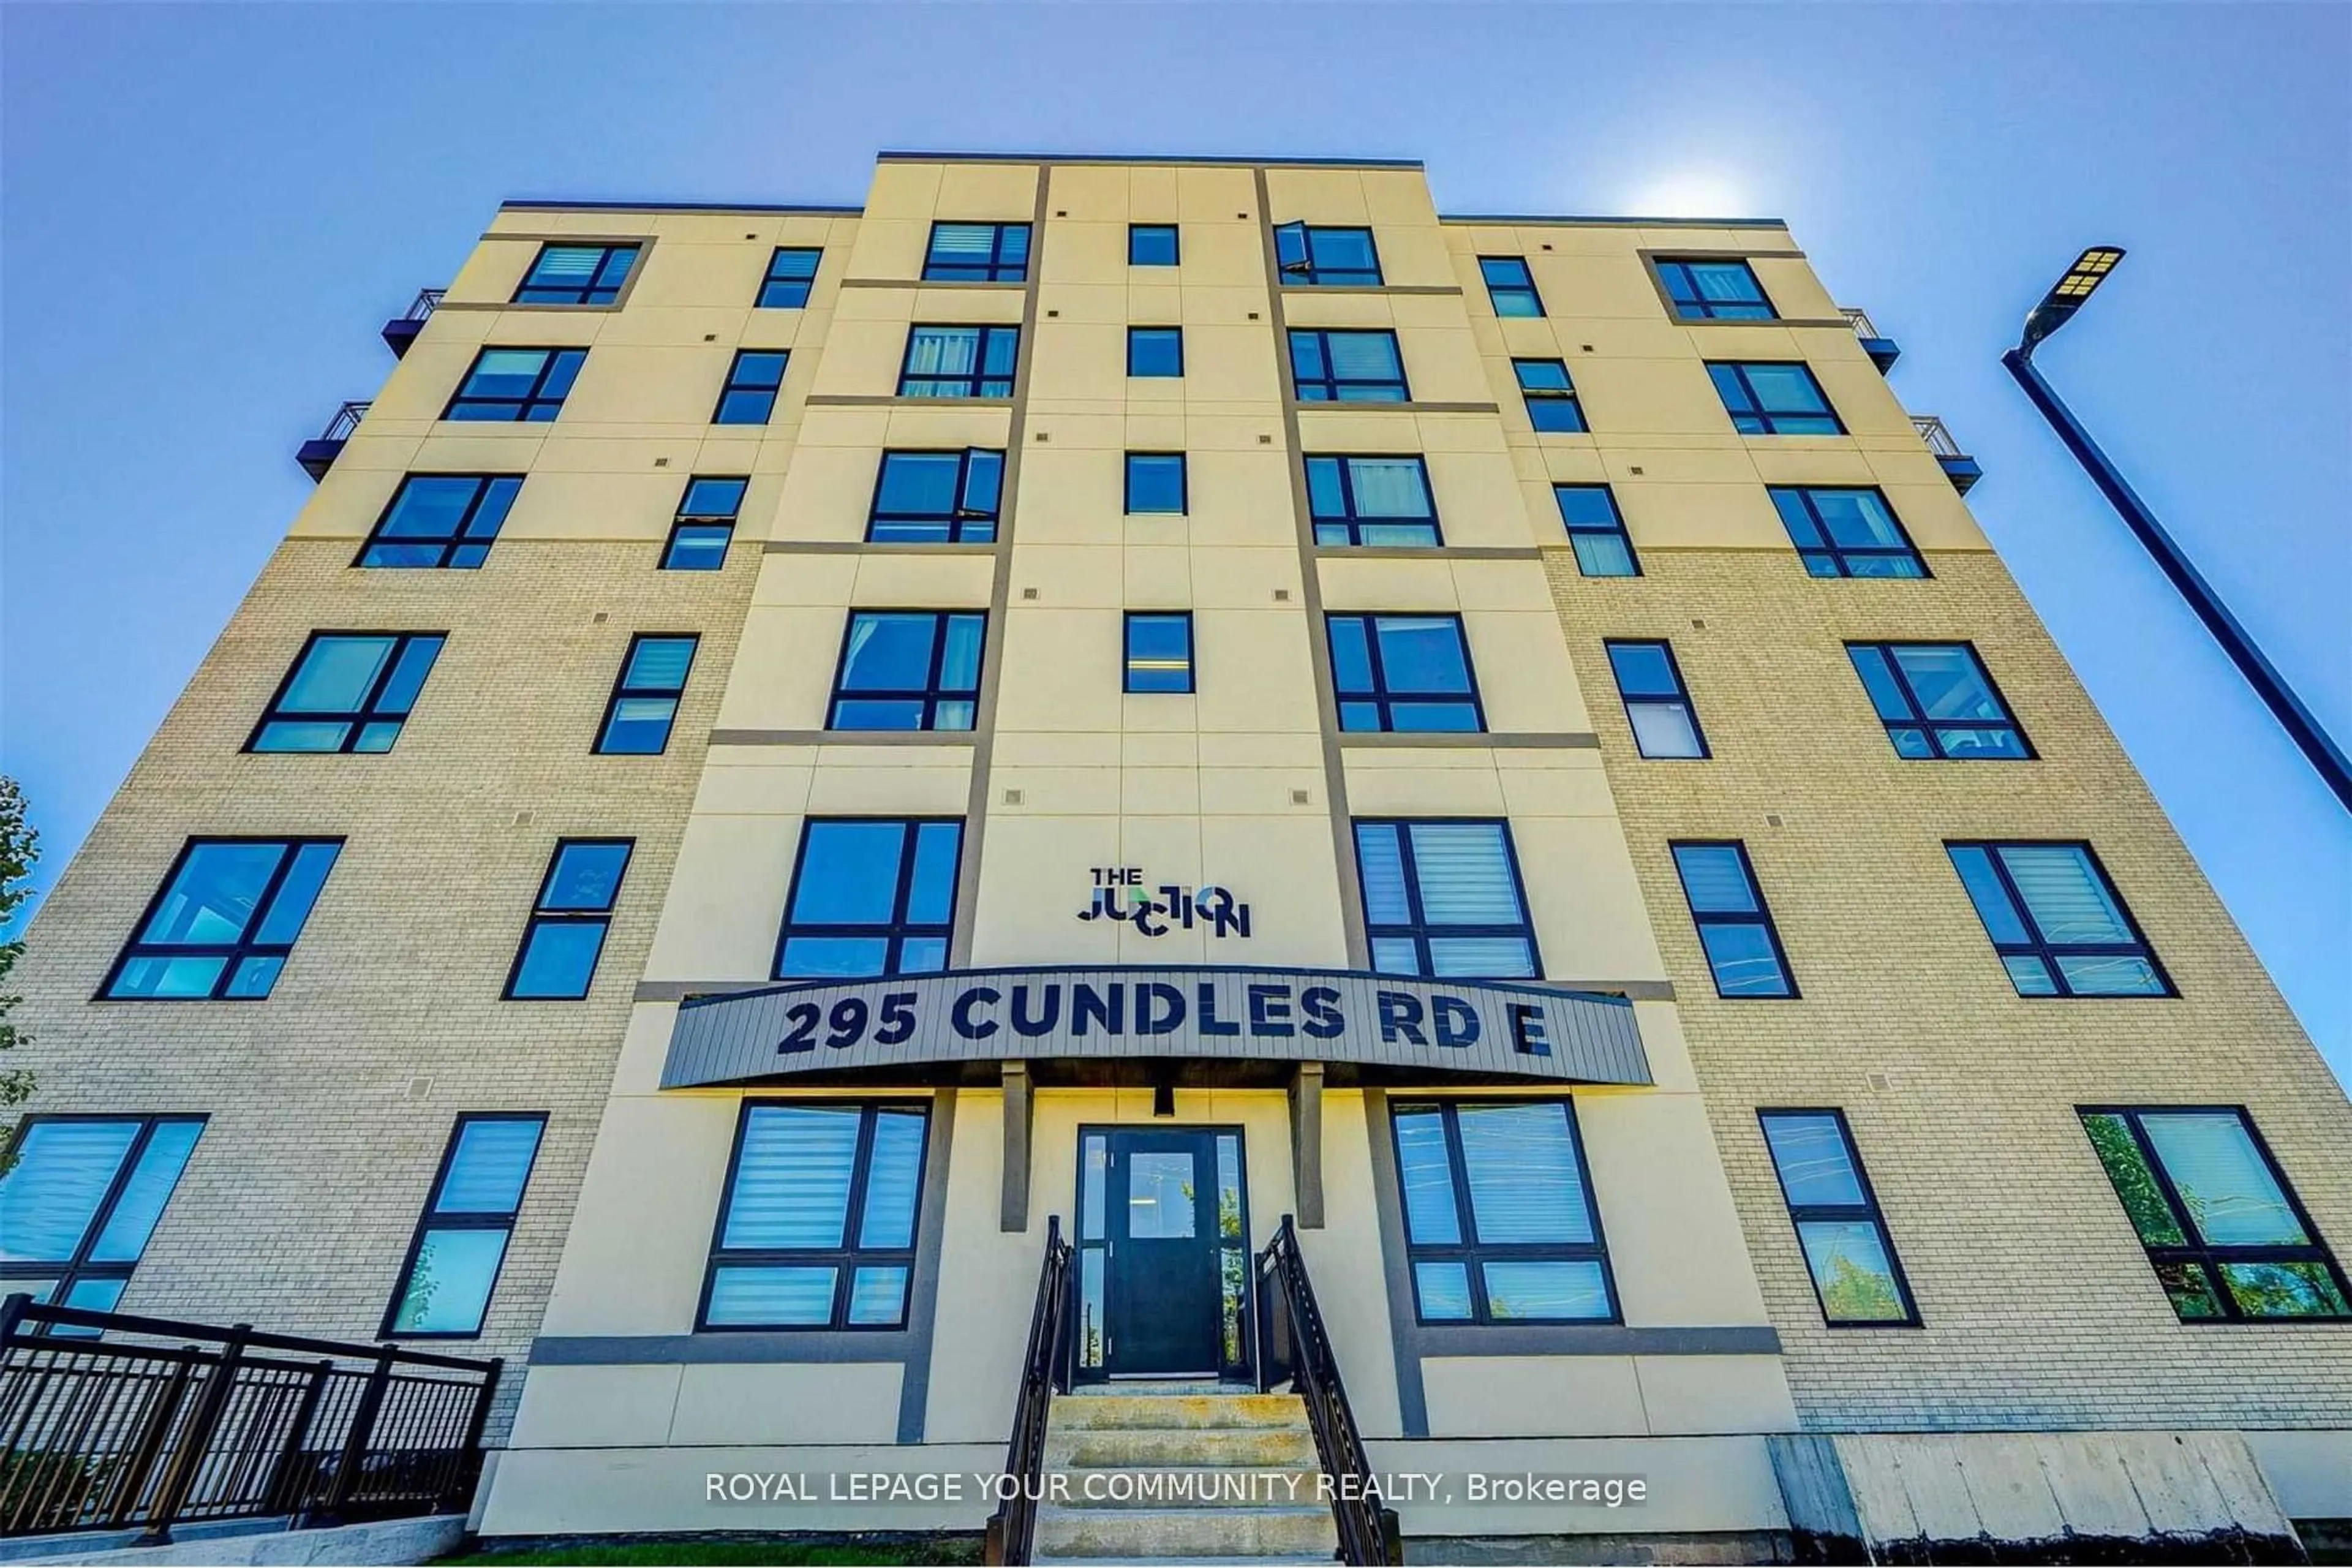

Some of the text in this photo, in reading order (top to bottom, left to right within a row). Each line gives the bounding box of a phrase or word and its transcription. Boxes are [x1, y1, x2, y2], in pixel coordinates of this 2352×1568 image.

[1090, 868, 1142, 886] THE
[777, 982, 1551, 1057] 295 CUNDLES RD E
